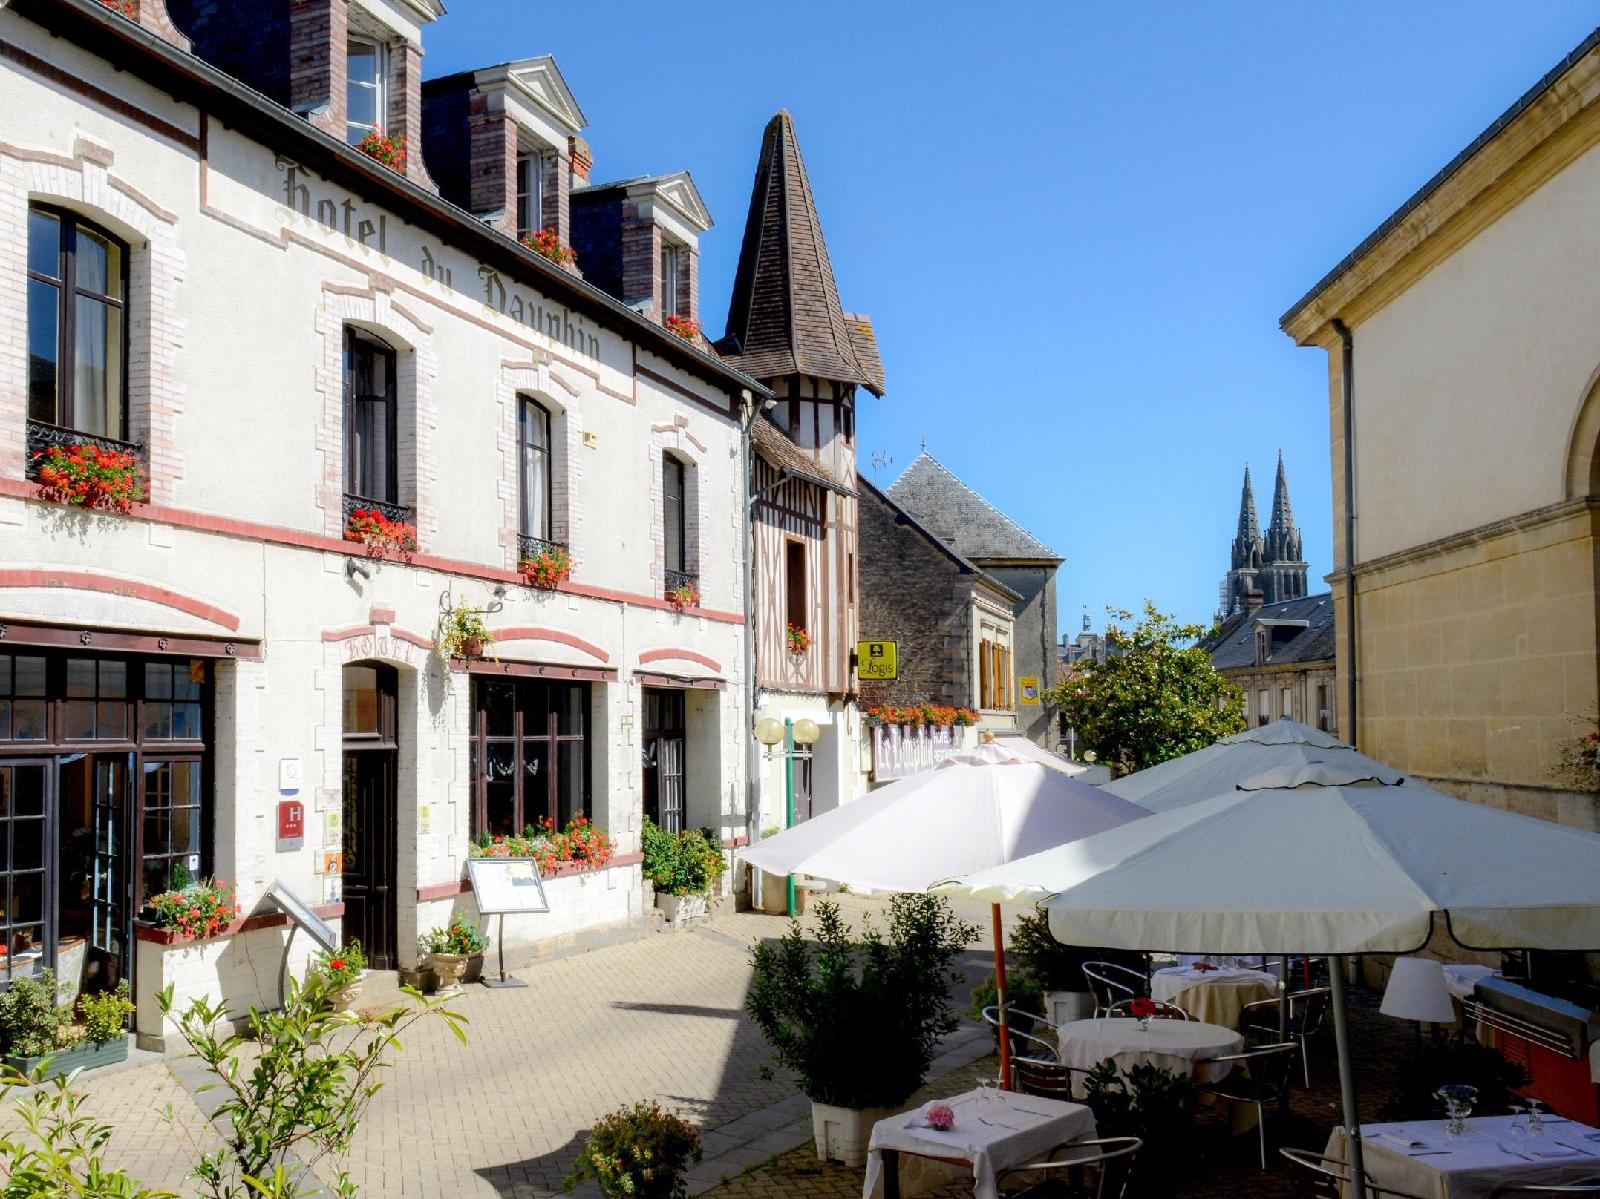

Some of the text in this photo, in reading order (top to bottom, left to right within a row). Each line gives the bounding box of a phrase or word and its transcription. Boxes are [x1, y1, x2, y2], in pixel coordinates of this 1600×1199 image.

[421, 246, 453, 297] du
[860, 657, 894, 677] Logis
[289, 806, 302, 821] H
